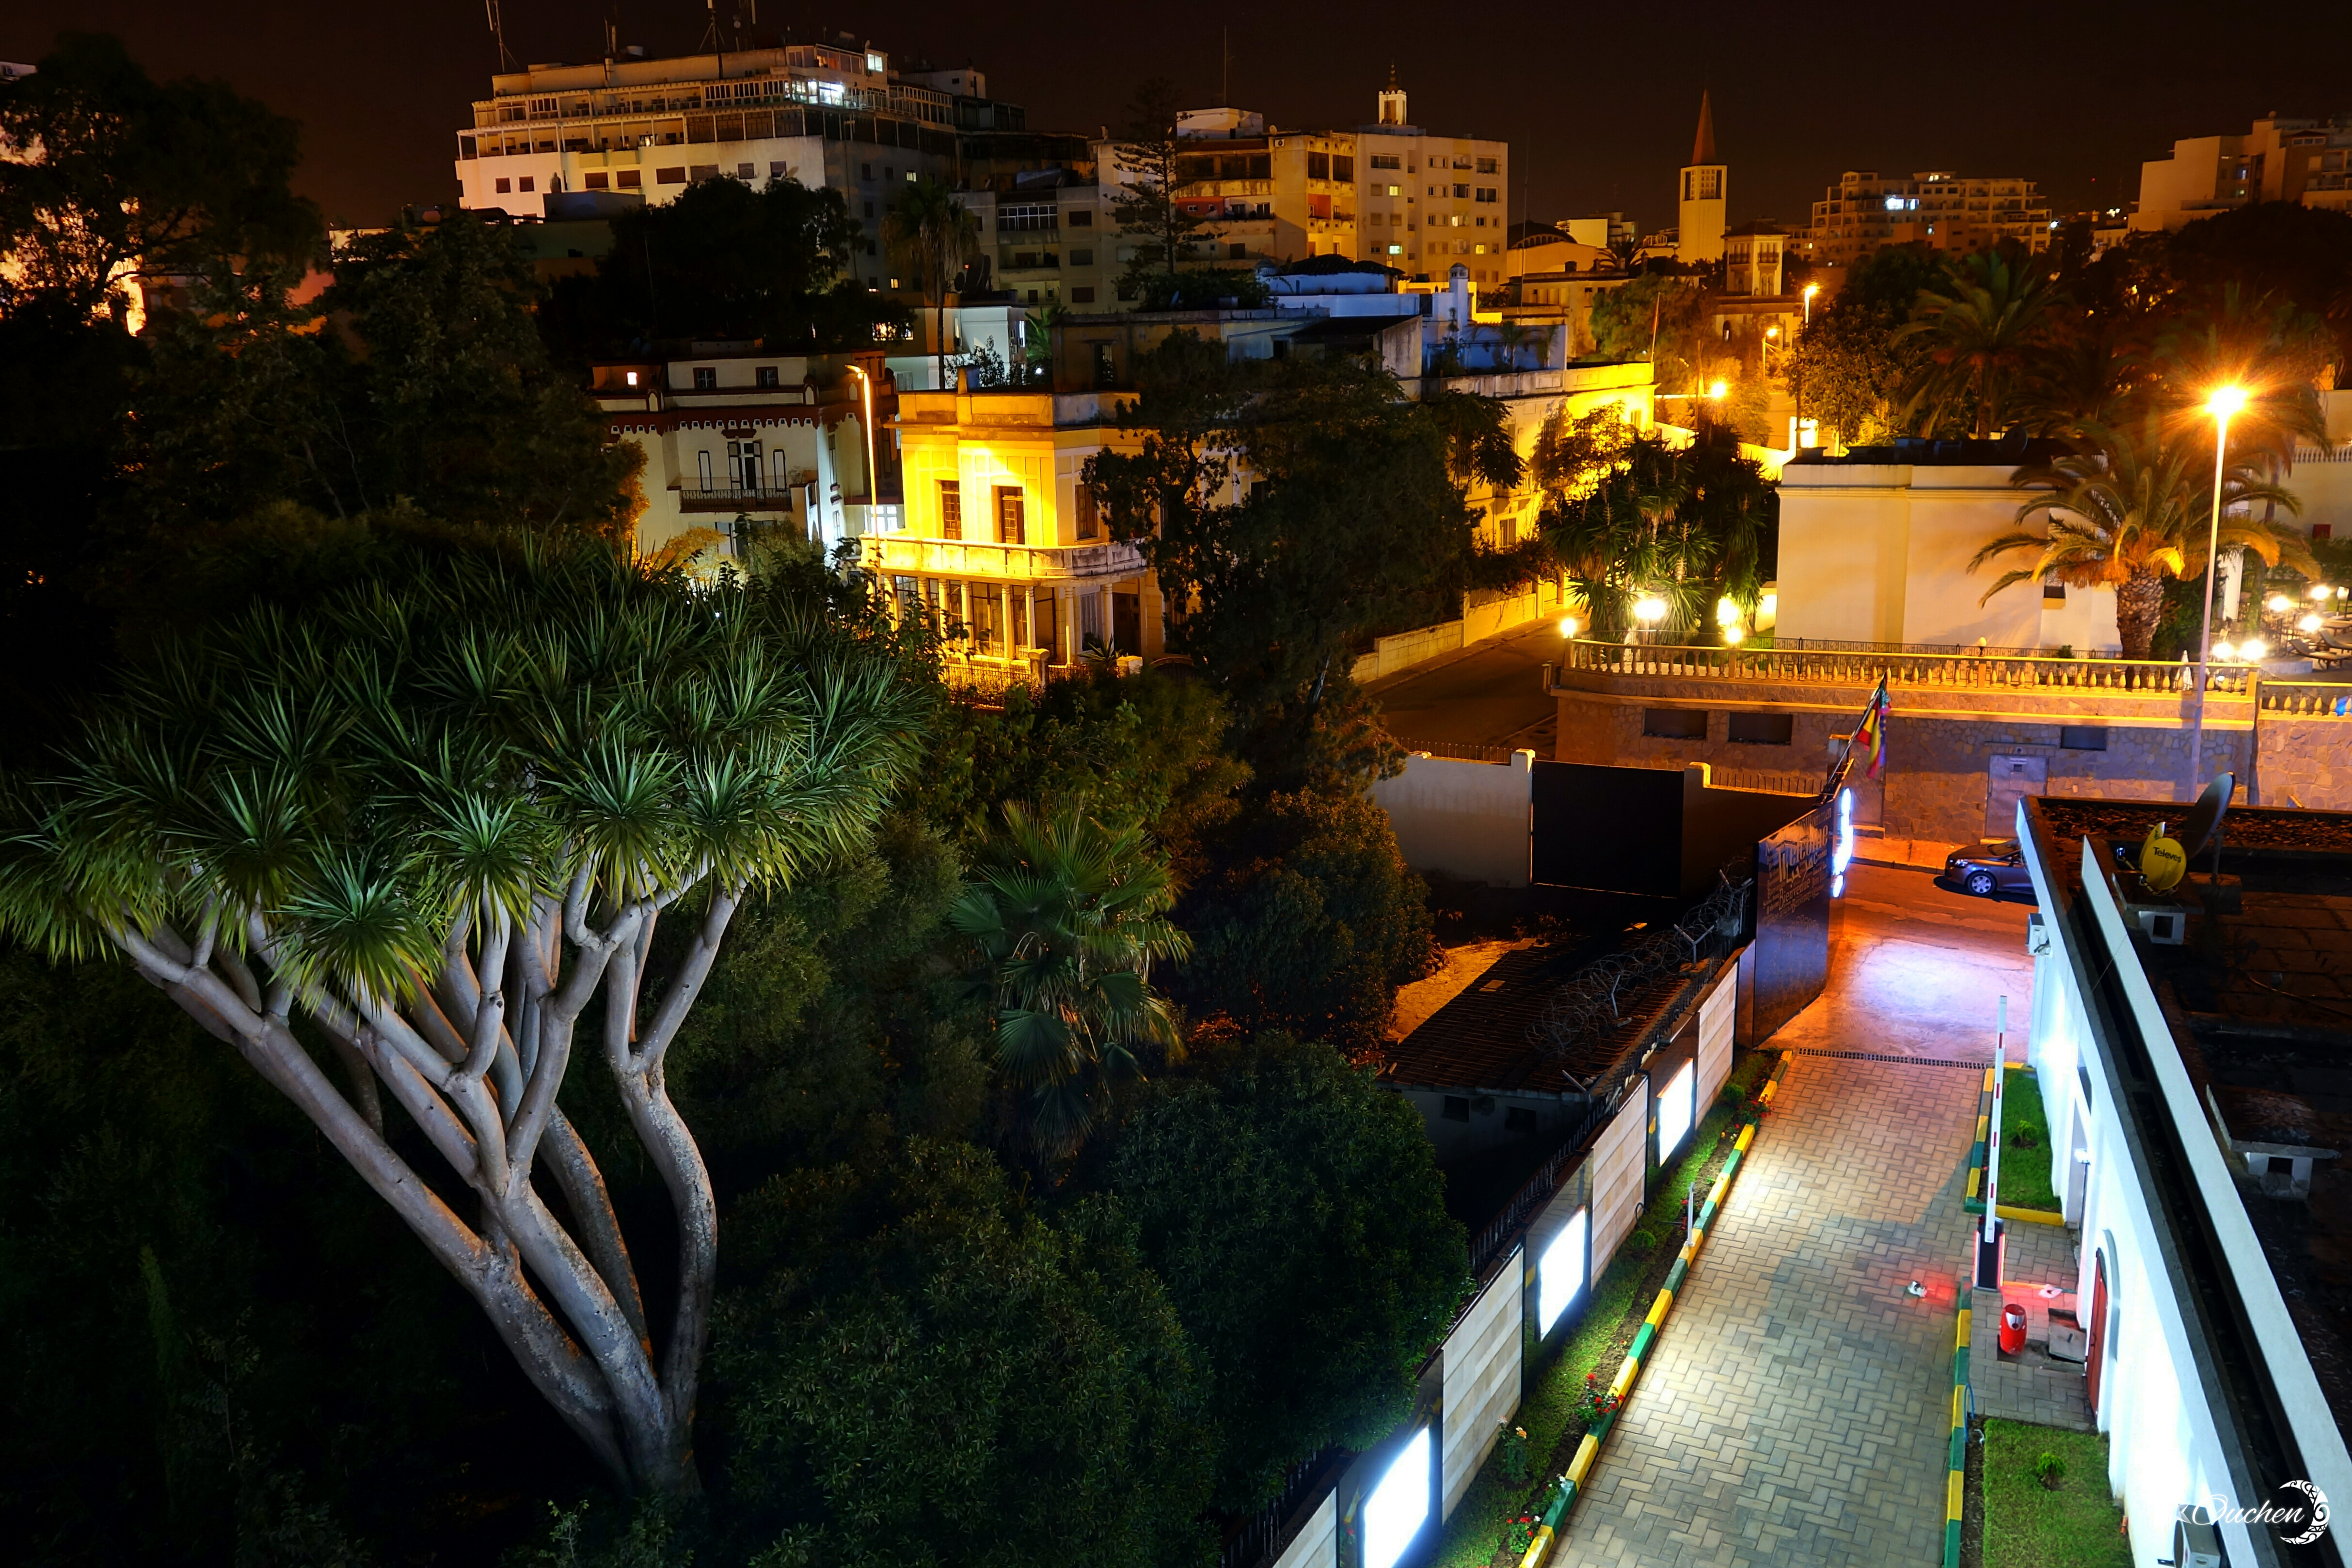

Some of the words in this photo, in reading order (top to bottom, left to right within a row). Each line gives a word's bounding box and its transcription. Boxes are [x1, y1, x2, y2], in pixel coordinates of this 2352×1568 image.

[1798, 808, 1831, 833] Willkommen
[1776, 825, 1828, 883] Welcome
[2153, 846, 2182, 863] Televes
[1779, 878, 1811, 911] Bienvenue
